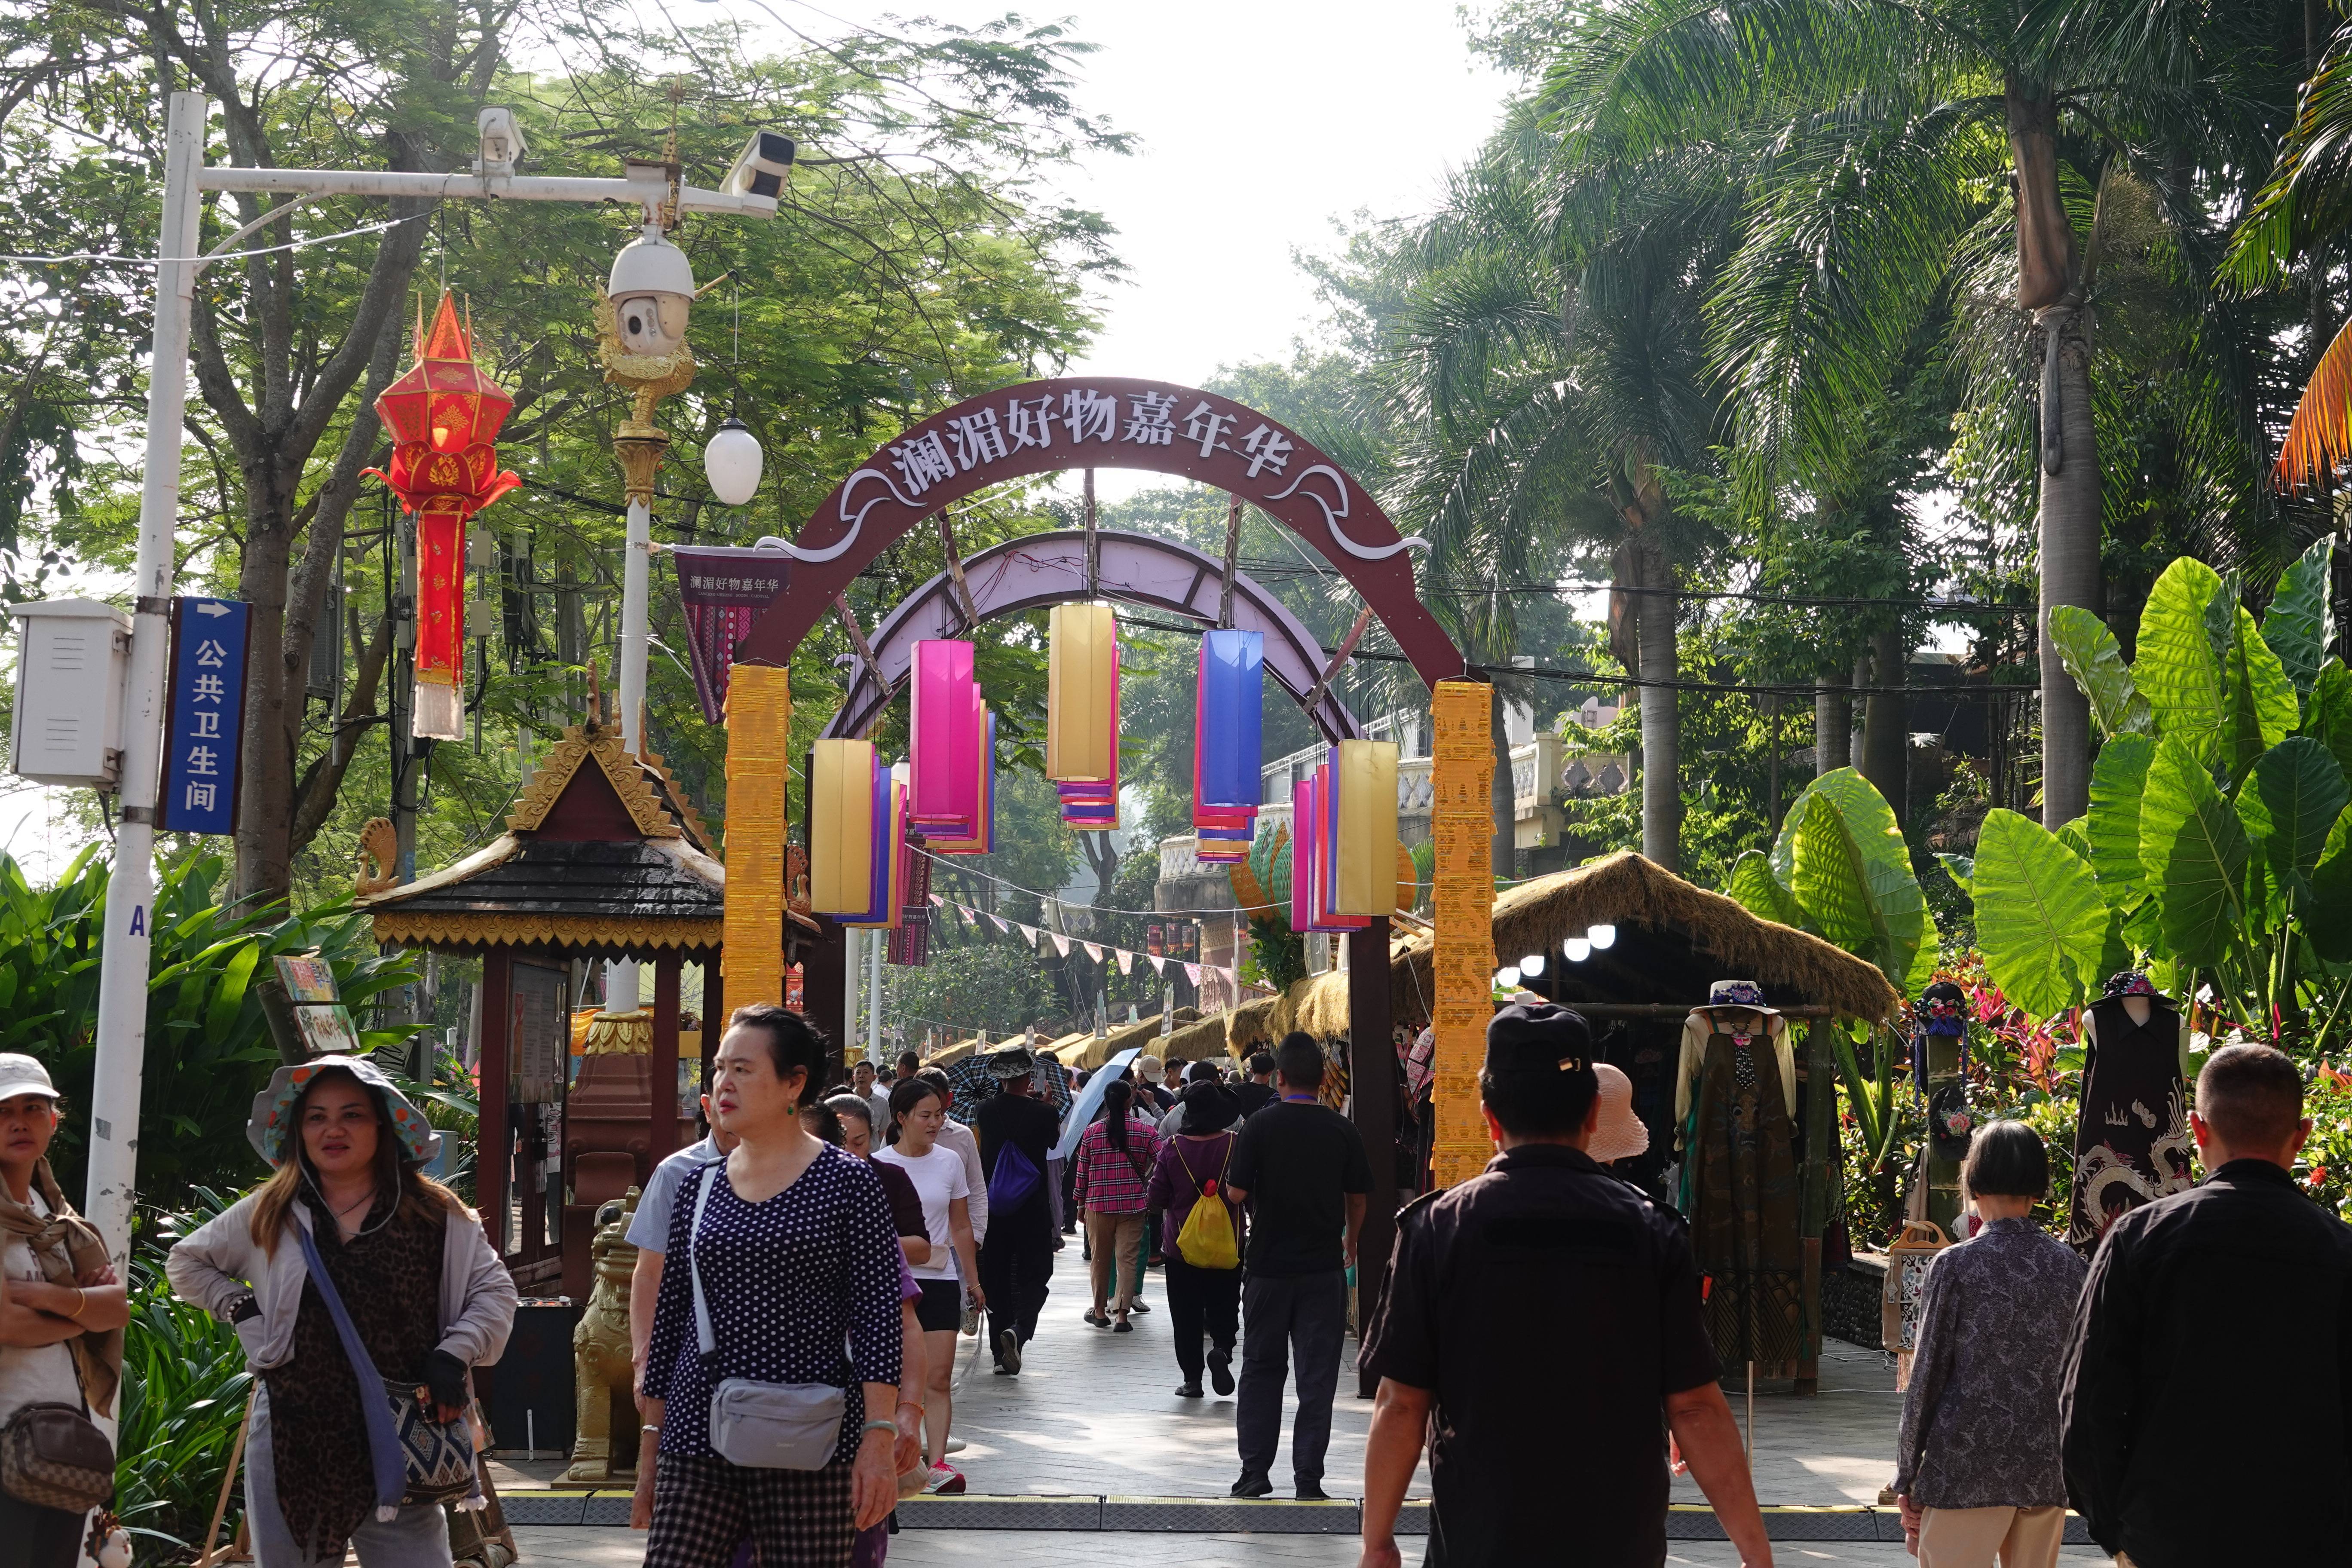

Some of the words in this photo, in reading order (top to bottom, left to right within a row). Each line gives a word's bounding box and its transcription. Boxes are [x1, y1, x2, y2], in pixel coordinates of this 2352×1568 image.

[891, 389, 1294, 495] 澜湄好物嘉年华
[690, 576, 778, 592] 澜湄好物嘉年华
[185, 640, 227, 812] 公共卫生间
